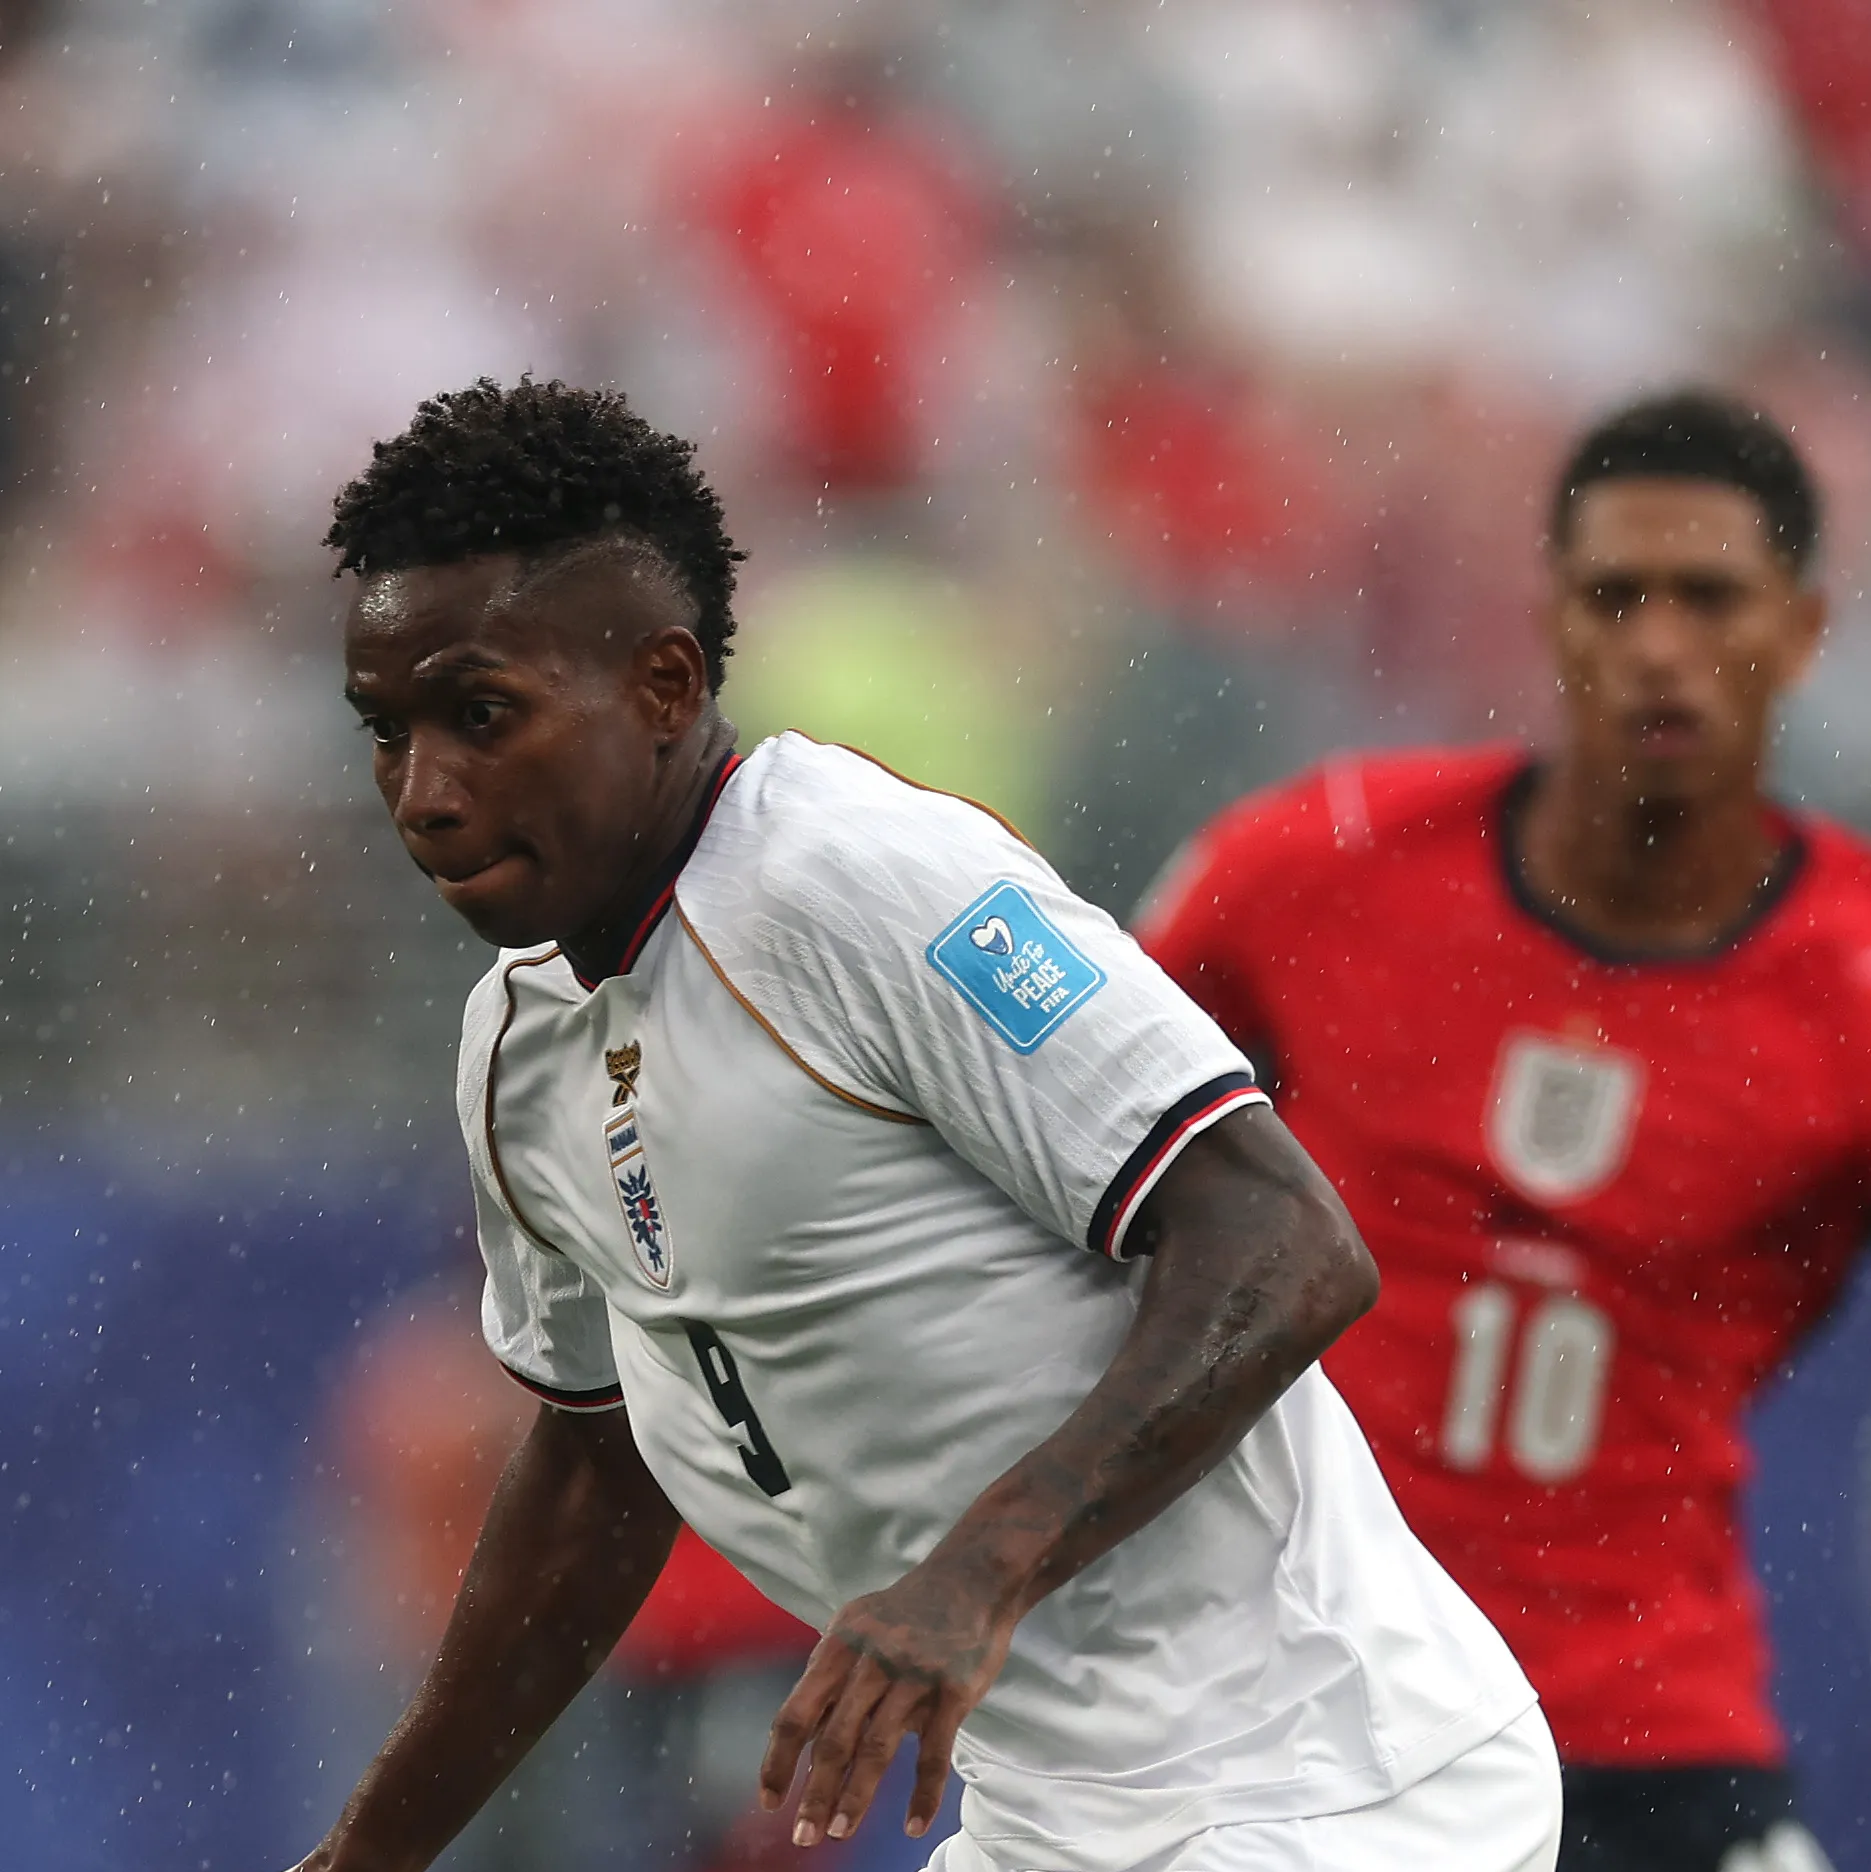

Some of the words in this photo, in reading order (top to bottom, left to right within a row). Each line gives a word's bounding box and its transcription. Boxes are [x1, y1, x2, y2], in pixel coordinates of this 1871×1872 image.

[992, 955, 1030, 993] Unite
[1022, 941, 1045, 964] For
[1012, 958, 1066, 1010] PEACE
[1040, 987, 1069, 1013] FIFA
[1441, 1280, 1616, 1480] 10
[680, 1317, 791, 1497] 9
